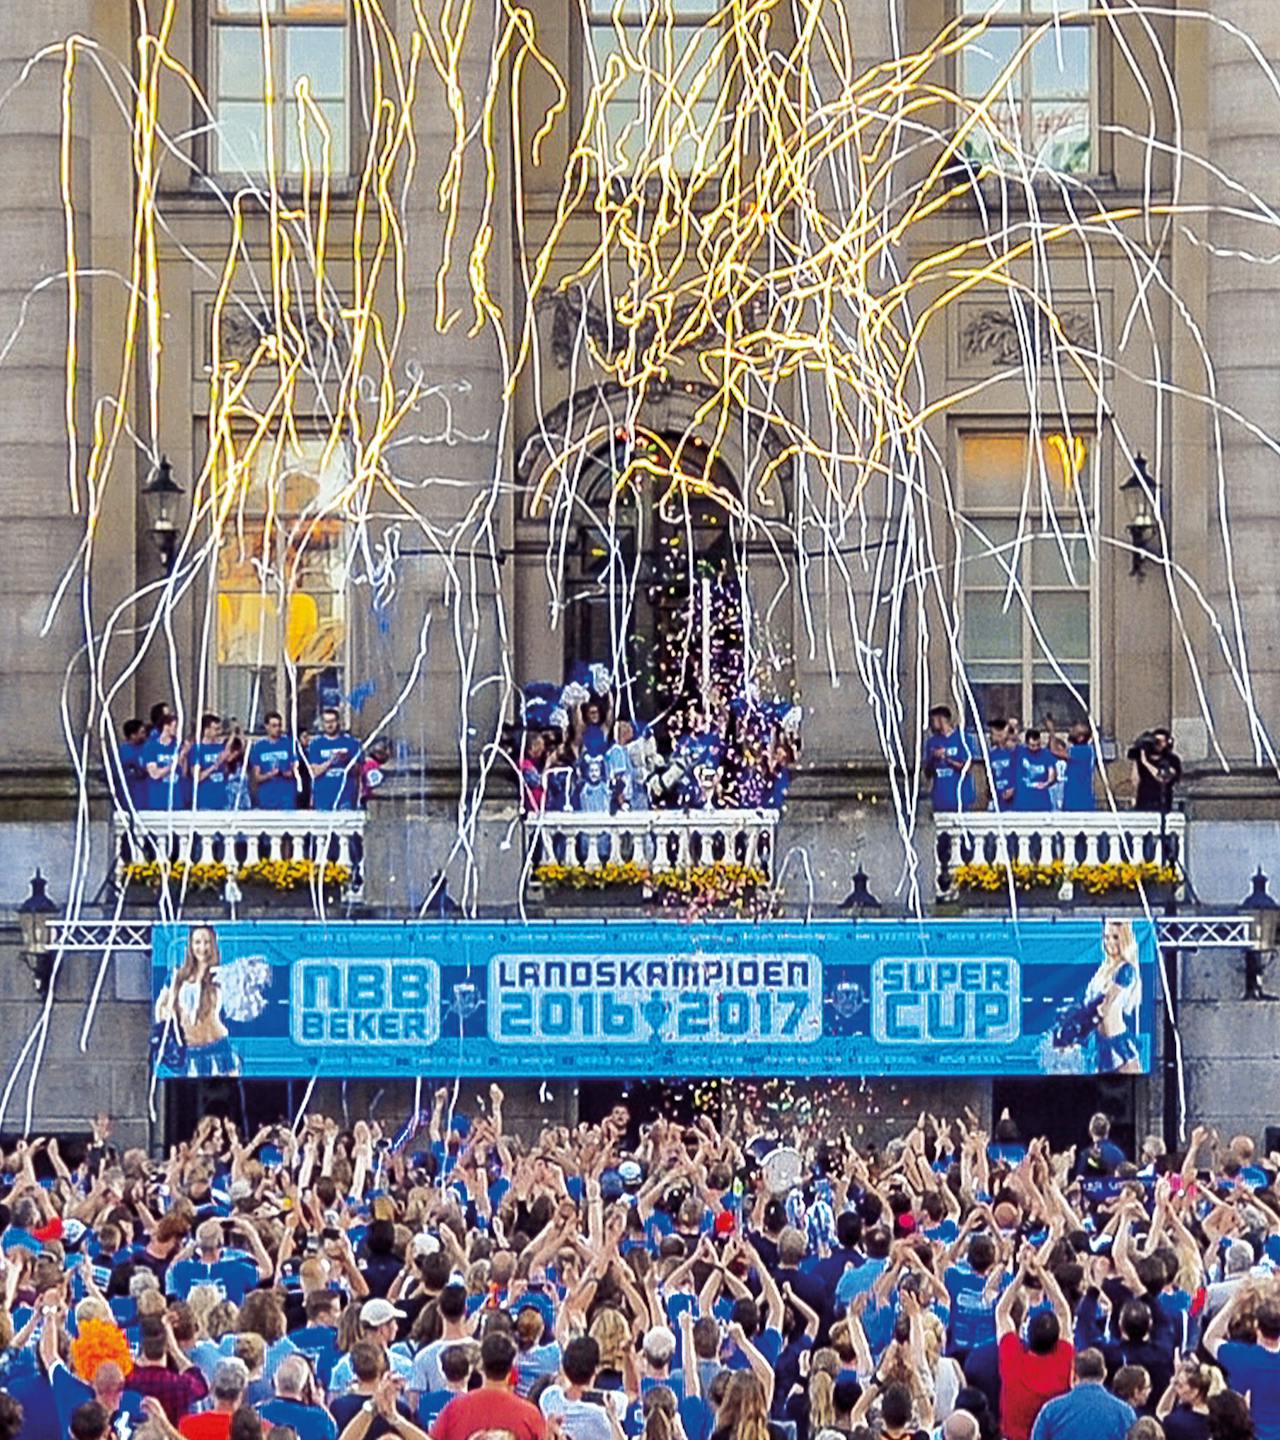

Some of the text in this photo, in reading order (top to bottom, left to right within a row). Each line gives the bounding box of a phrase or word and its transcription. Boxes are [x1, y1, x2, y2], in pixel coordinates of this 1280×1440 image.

[303, 966, 429, 1008] NBB
[499, 962, 809, 987] LANDSKAMPIOEN
[883, 963, 1008, 991] SUPER
[303, 1011, 428, 1039] BEKER
[500, 992, 809, 1035] 2016 2017
[885, 994, 1008, 1039] CUP
